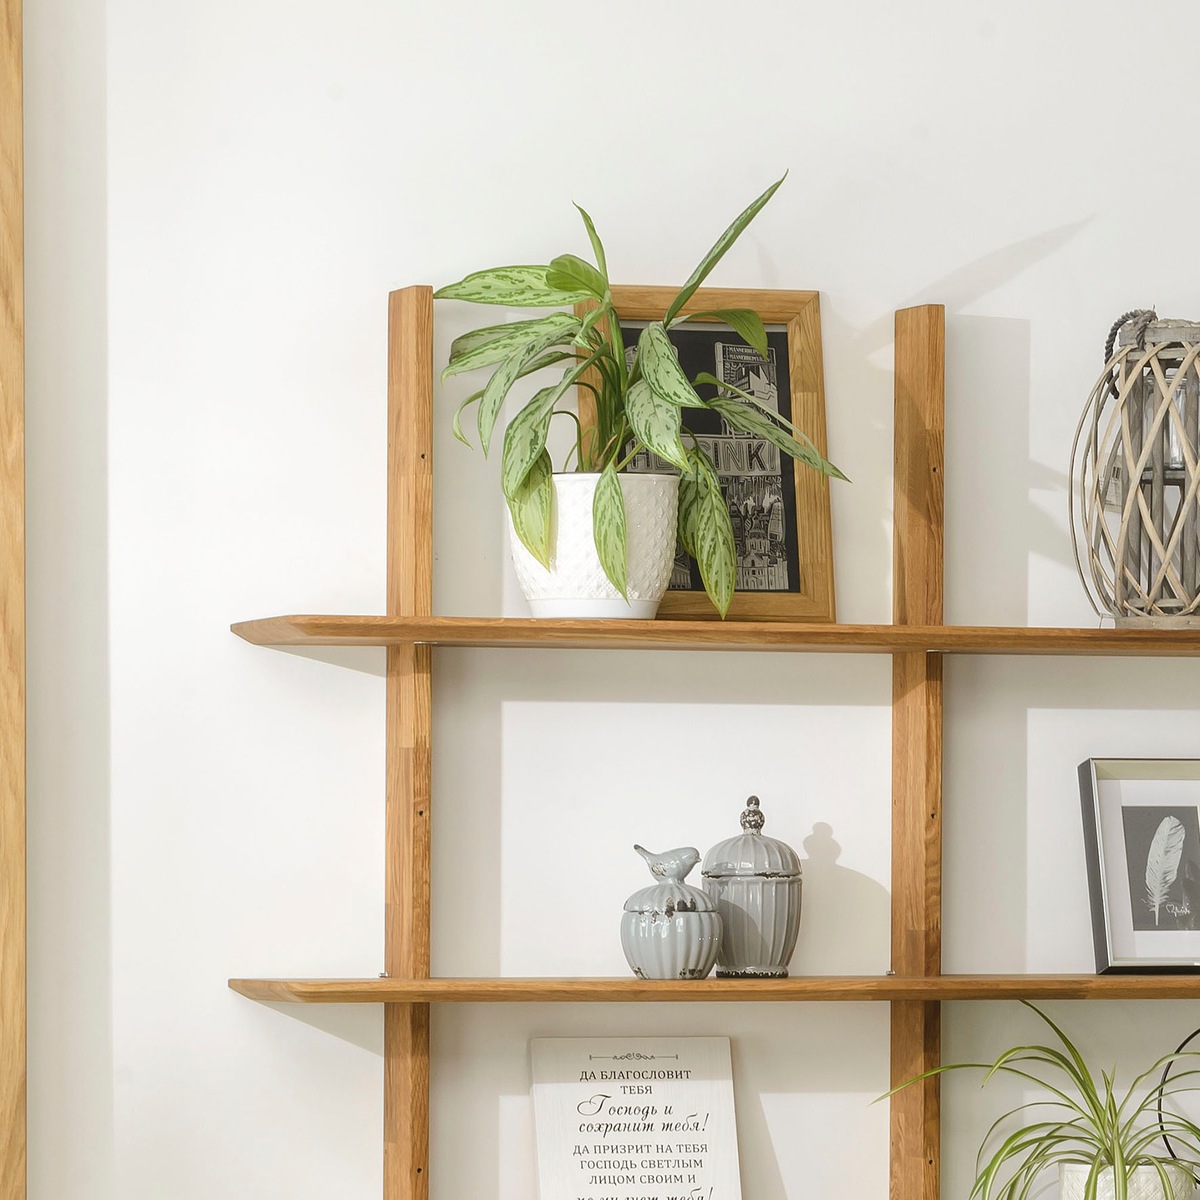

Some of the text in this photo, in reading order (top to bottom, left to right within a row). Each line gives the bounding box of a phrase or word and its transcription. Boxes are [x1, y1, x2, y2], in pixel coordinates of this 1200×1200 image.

[630, 437, 777, 471] HINKI
[580, 1070, 692, 1081] ДА БЛАГОСЛОВИТ
[620, 1085, 653, 1095] ТЕБЯ
[576, 1093, 674, 1121] Господь и
[578, 1112, 710, 1138] сохранит тебя!
[573, 1143, 709, 1156] ДА ПРИЗРИТ НА ТЕБЯ
[580, 1158, 704, 1171] ГОСПОДЬ СВЕТЛЫМ
[589, 1174, 697, 1186] ЛИЦОМ СВОИМ И
